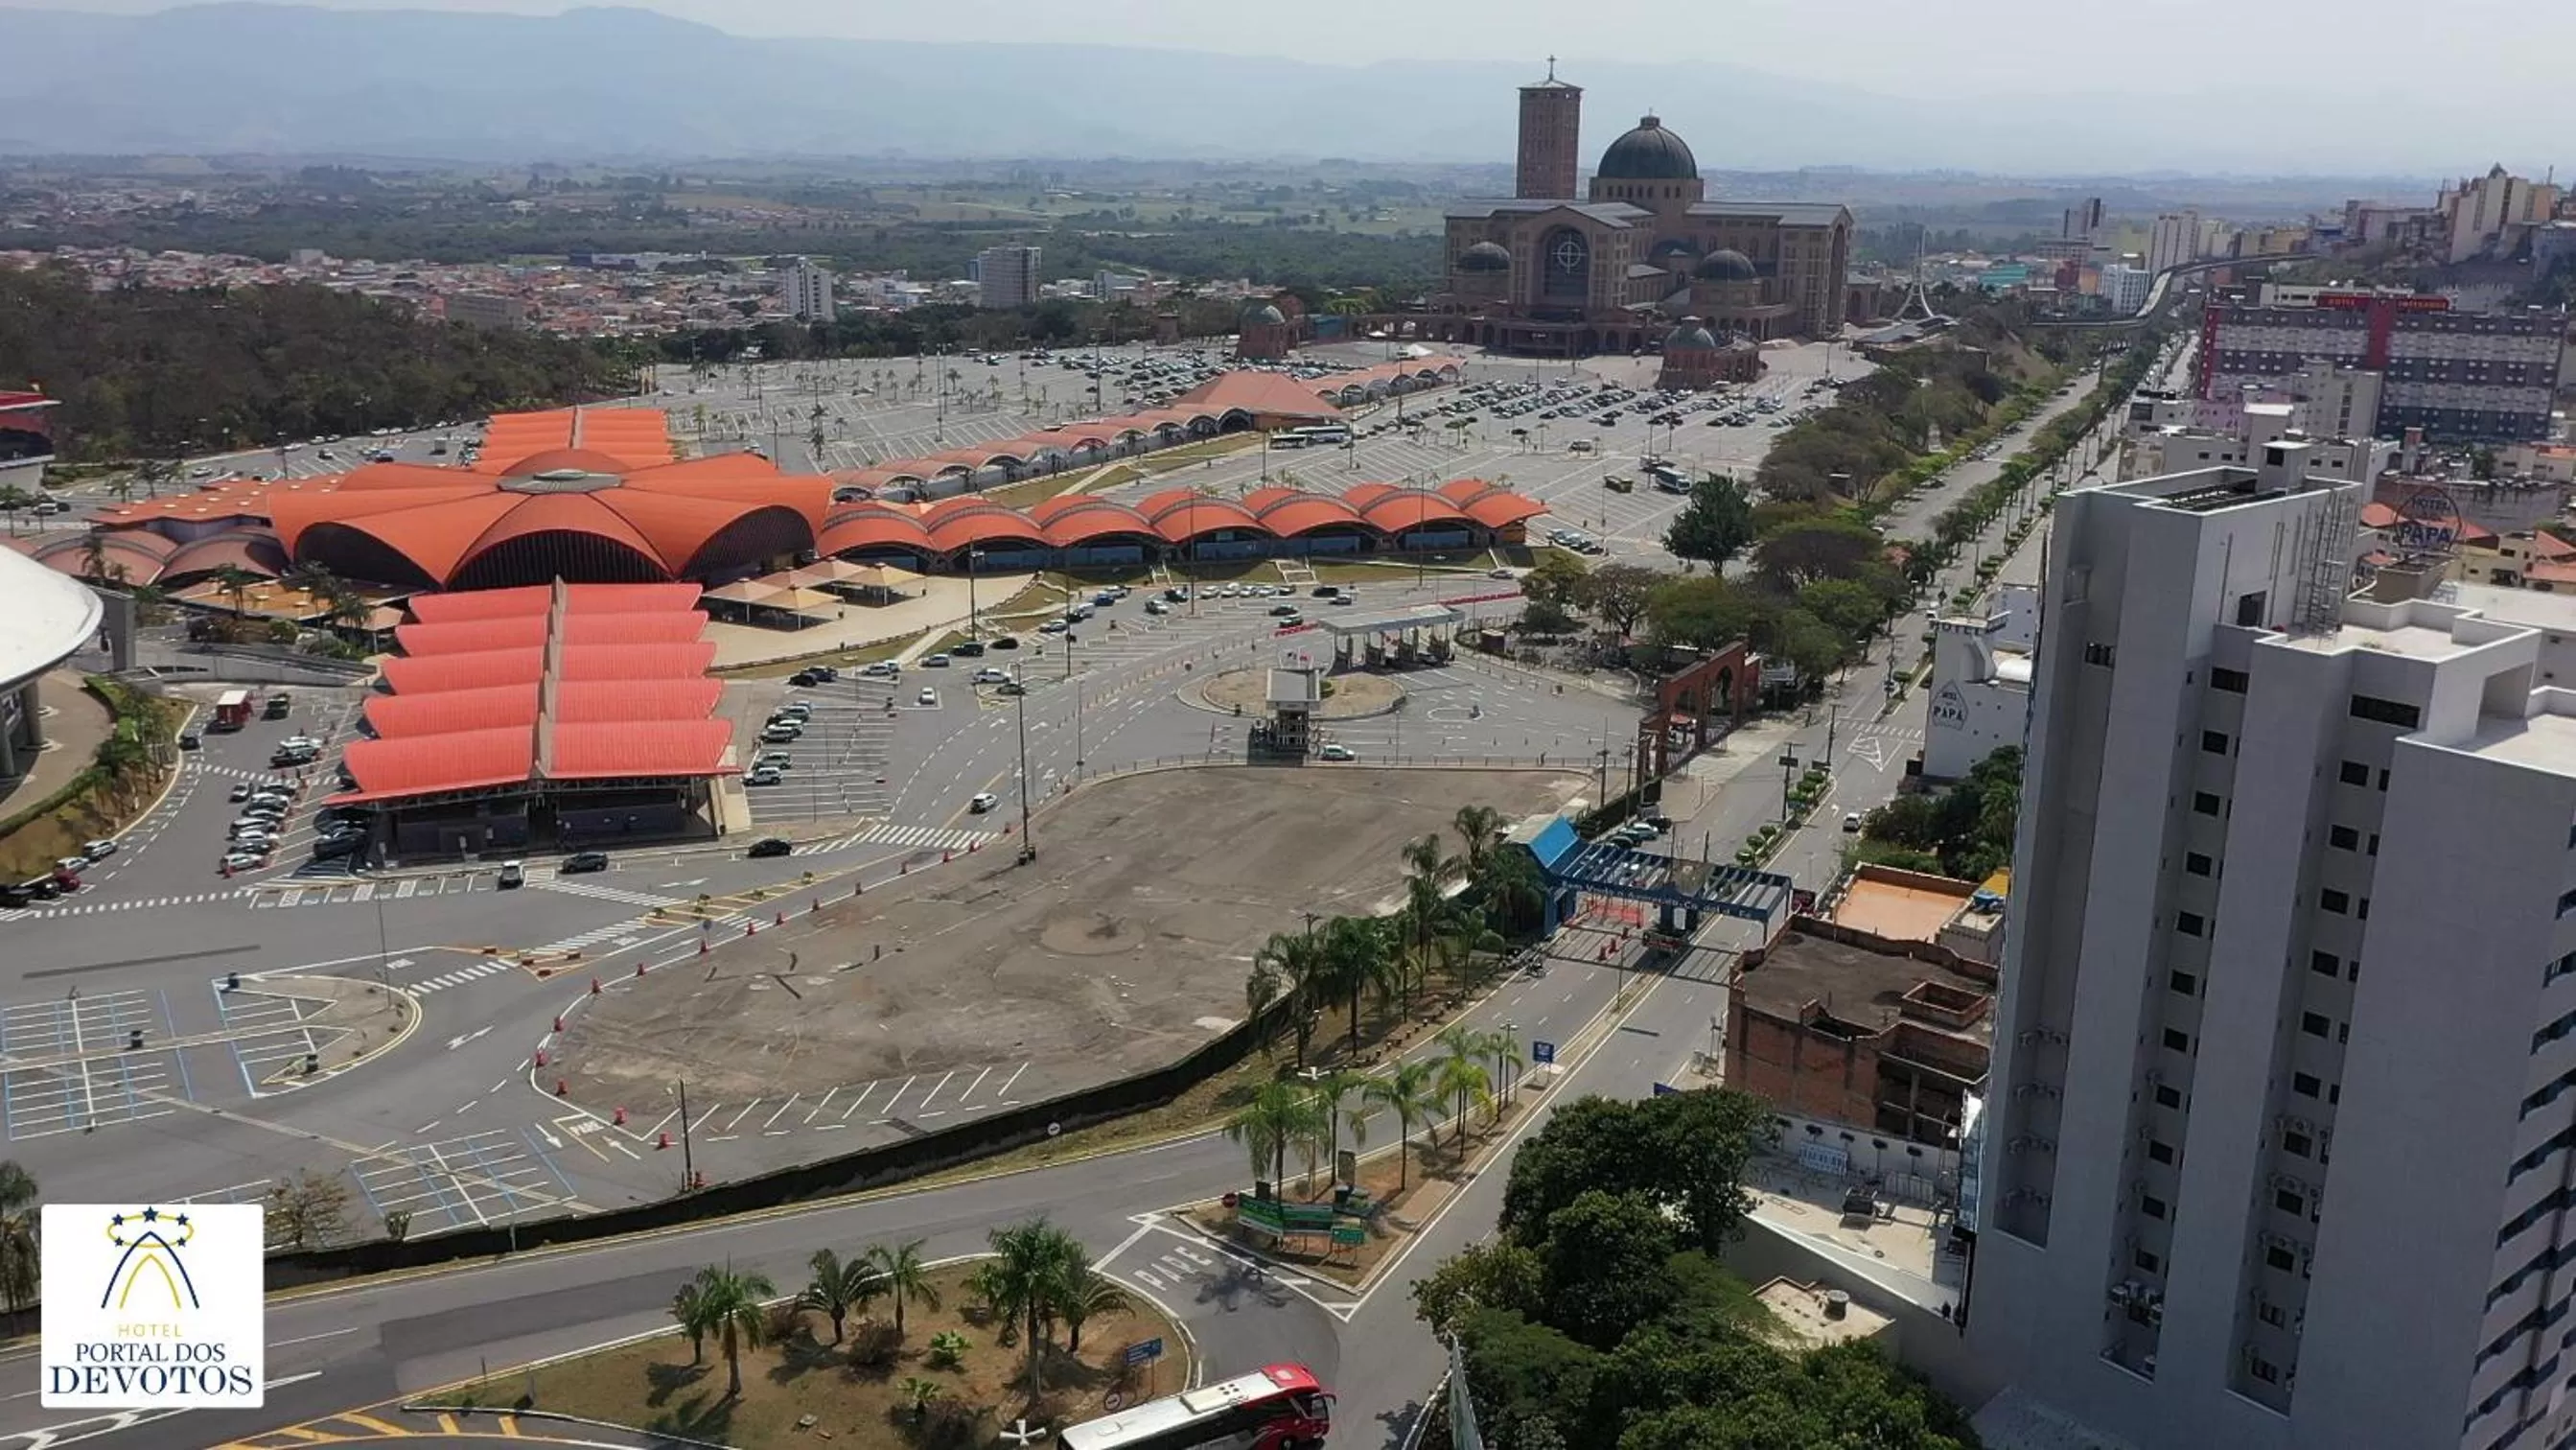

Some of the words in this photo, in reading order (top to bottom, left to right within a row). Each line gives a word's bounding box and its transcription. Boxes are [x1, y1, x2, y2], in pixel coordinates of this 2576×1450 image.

[2411, 497, 2450, 512] HOTEL
[2400, 525, 2451, 544] PAPA
[1933, 706, 1963, 721] PAPA
[1134, 1246, 1213, 1292] PARE
